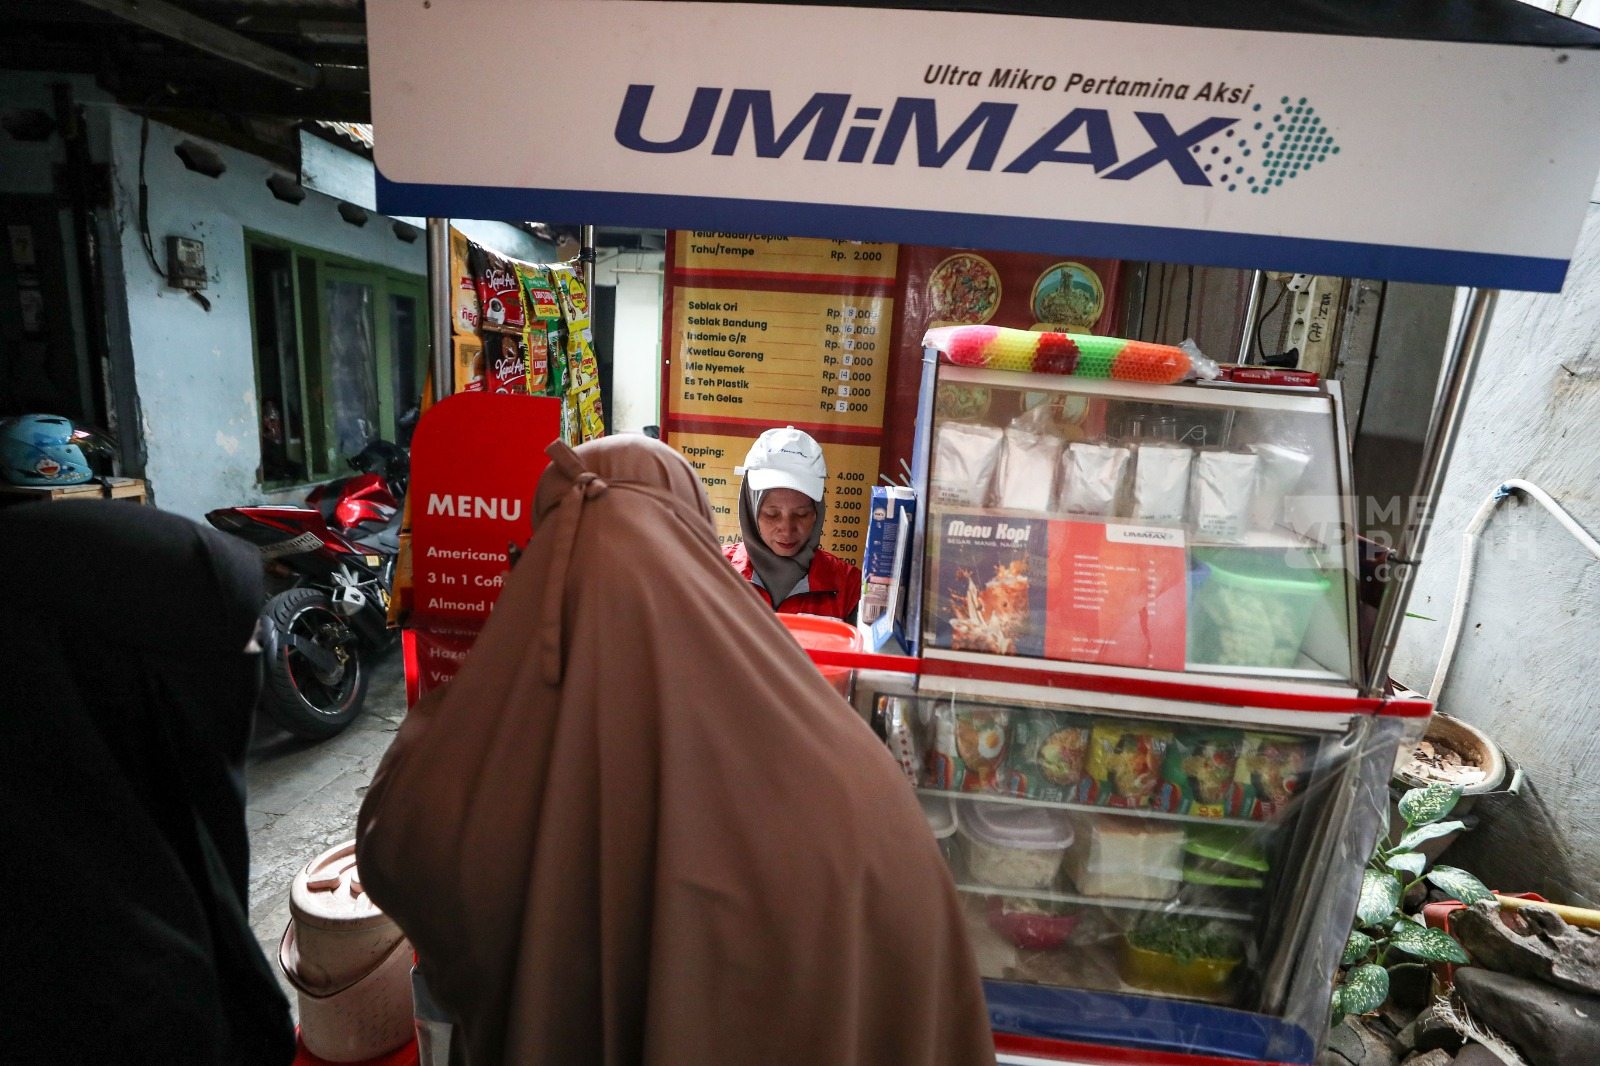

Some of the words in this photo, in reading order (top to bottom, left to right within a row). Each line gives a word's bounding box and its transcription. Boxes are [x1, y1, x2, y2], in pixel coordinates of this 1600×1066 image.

[923, 64, 981, 87] Ultra
[987, 69, 1057, 93] Mikro
[1065, 73, 1189, 101] Pertamina
[1195, 82, 1256, 105] Aksi
[614, 84, 1241, 188] UMiMAX
[690, 243, 755, 258] Tahu/Tempe
[830, 250, 846, 261] Rp.
[853, 251, 882, 261] 2.000
[688, 301, 721, 311] Seblak
[723, 302, 738, 312] Ori
[827, 308, 842, 319] Rp.
[688, 316, 721, 327] Seblak
[722, 318, 768, 331] Bandung
[826, 324, 841, 335] Rp.
[844, 325, 876, 335] 16.000
[687, 332, 727, 342] Indomie
[729, 333, 747, 344] G/R
[825, 340, 840, 350] Rp.
[847, 341, 875, 351] 7.000
[686, 347, 726, 357] Kwetiau
[727, 349, 764, 361] Goreng
[823, 355, 839, 366] Rp.
[685, 362, 705, 372] Mie
[706, 363, 745, 374] Nyemek
[822, 371, 838, 381] Rp.
[840, 371, 871, 381] 14.000
[685, 377, 696, 386] Es
[698, 377, 715, 387] Teh
[717, 379, 749, 389] Plastik
[821, 386, 837, 396] Rp.
[842, 387, 871, 397] 3.000
[684, 392, 695, 401] Es
[697, 392, 715, 402] Teh
[716, 394, 743, 404] Gelas
[820, 401, 836, 412] Rp.
[839, 402, 868, 412] 5.000
[681, 446, 724, 458] Topping:
[688, 461, 706, 469] elur
[837, 472, 865, 481] 4.000
[701, 477, 727, 486] ngan
[836, 487, 862, 496] 2.000
[426, 493, 521, 521] MENU
[835, 501, 862, 510] 3.000
[834, 515, 860, 524] 3.000
[832, 529, 859, 538] 2.500
[947, 520, 992, 539] Menu
[995, 523, 1031, 543] Kopi
[426, 546, 507, 562] Americano
[831, 543, 858, 552] 2.500
[427, 573, 437, 584] 3
[441, 573, 456, 585] In
[462, 574, 468, 586] 1
[474, 575, 505, 588] Coff
[428, 598, 485, 612] Almond
